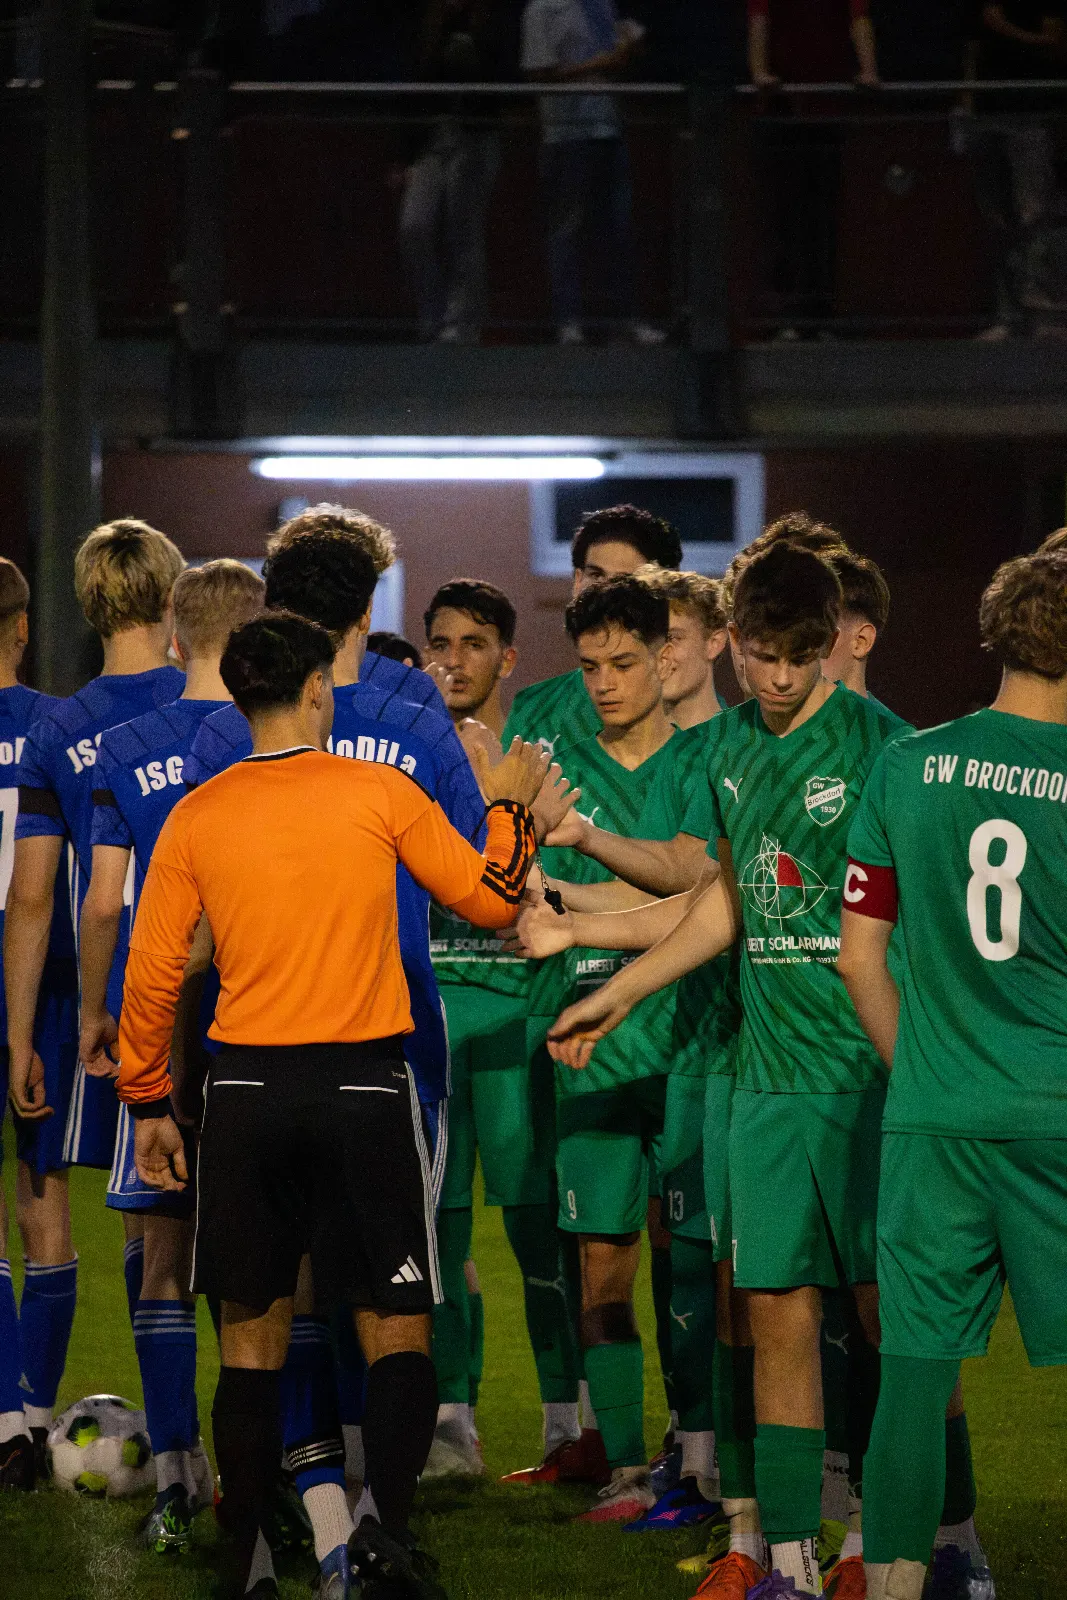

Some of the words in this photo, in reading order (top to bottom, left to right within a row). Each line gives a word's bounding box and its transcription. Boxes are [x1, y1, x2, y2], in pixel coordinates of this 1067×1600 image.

[66, 732, 102, 774] JS
[923, 755, 958, 784] GW
[134, 756, 184, 797] JSG
[843, 863, 869, 903] C
[966, 818, 1028, 962] 8
[768, 935, 842, 951] SCHLARMAN
[567, 1189, 577, 1219] 9
[668, 1189, 684, 1221] 13
